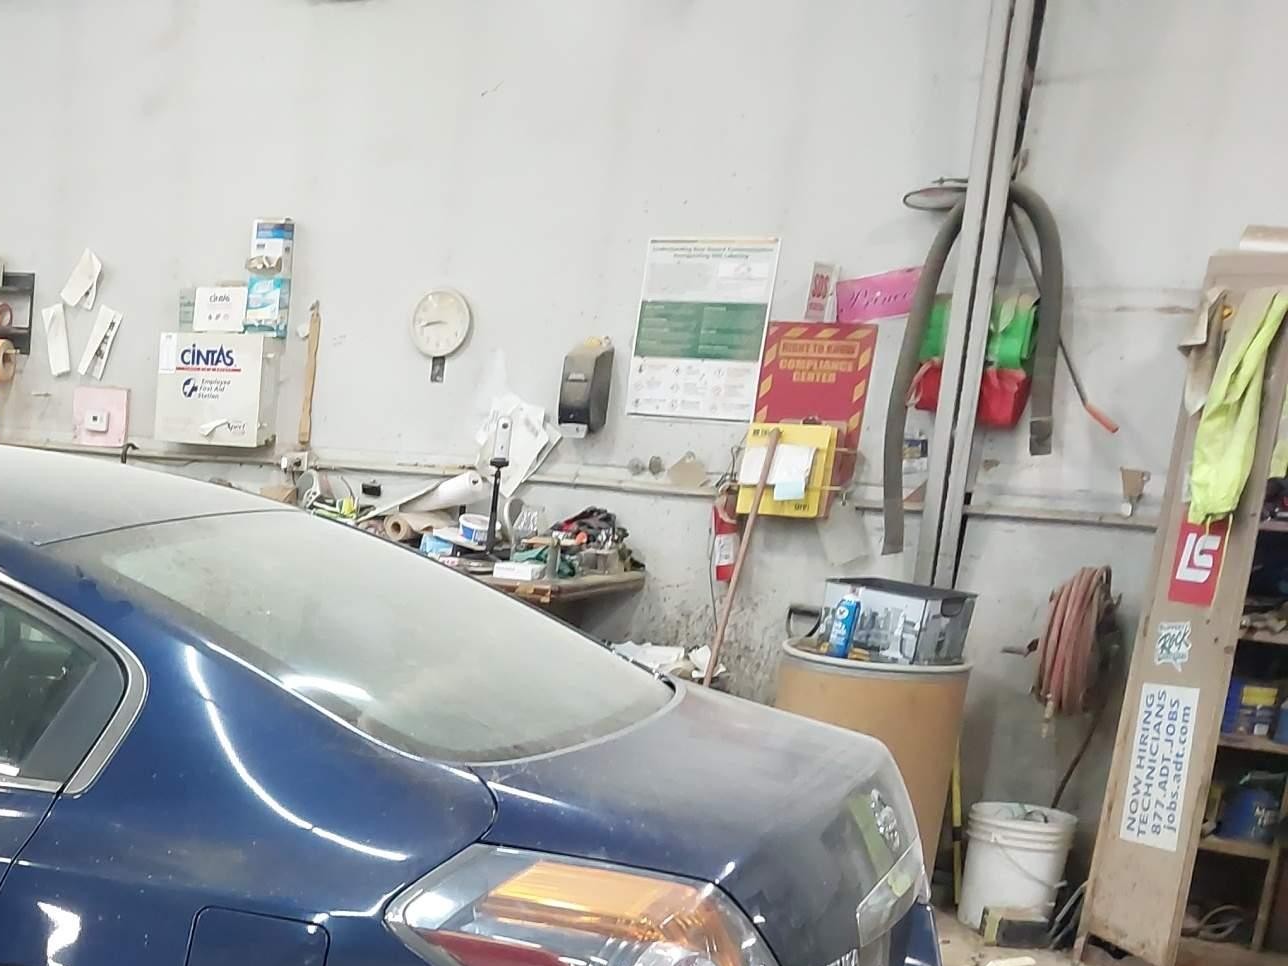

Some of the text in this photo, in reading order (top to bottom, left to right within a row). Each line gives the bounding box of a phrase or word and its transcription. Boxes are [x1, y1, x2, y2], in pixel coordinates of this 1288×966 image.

[180, 343, 235, 367] CINTAS
[779, 359, 854, 373] COMPLIANCE
[792, 371, 837, 383] CENTER
[197, 392, 220, 400] Station
[199, 385, 226, 393] First Aid
[1126, 693, 1156, 832] NOW HIRING
[1137, 689, 1168, 837] TECHNICIANS
[1163, 705, 1192, 833] jobs.adt.com
